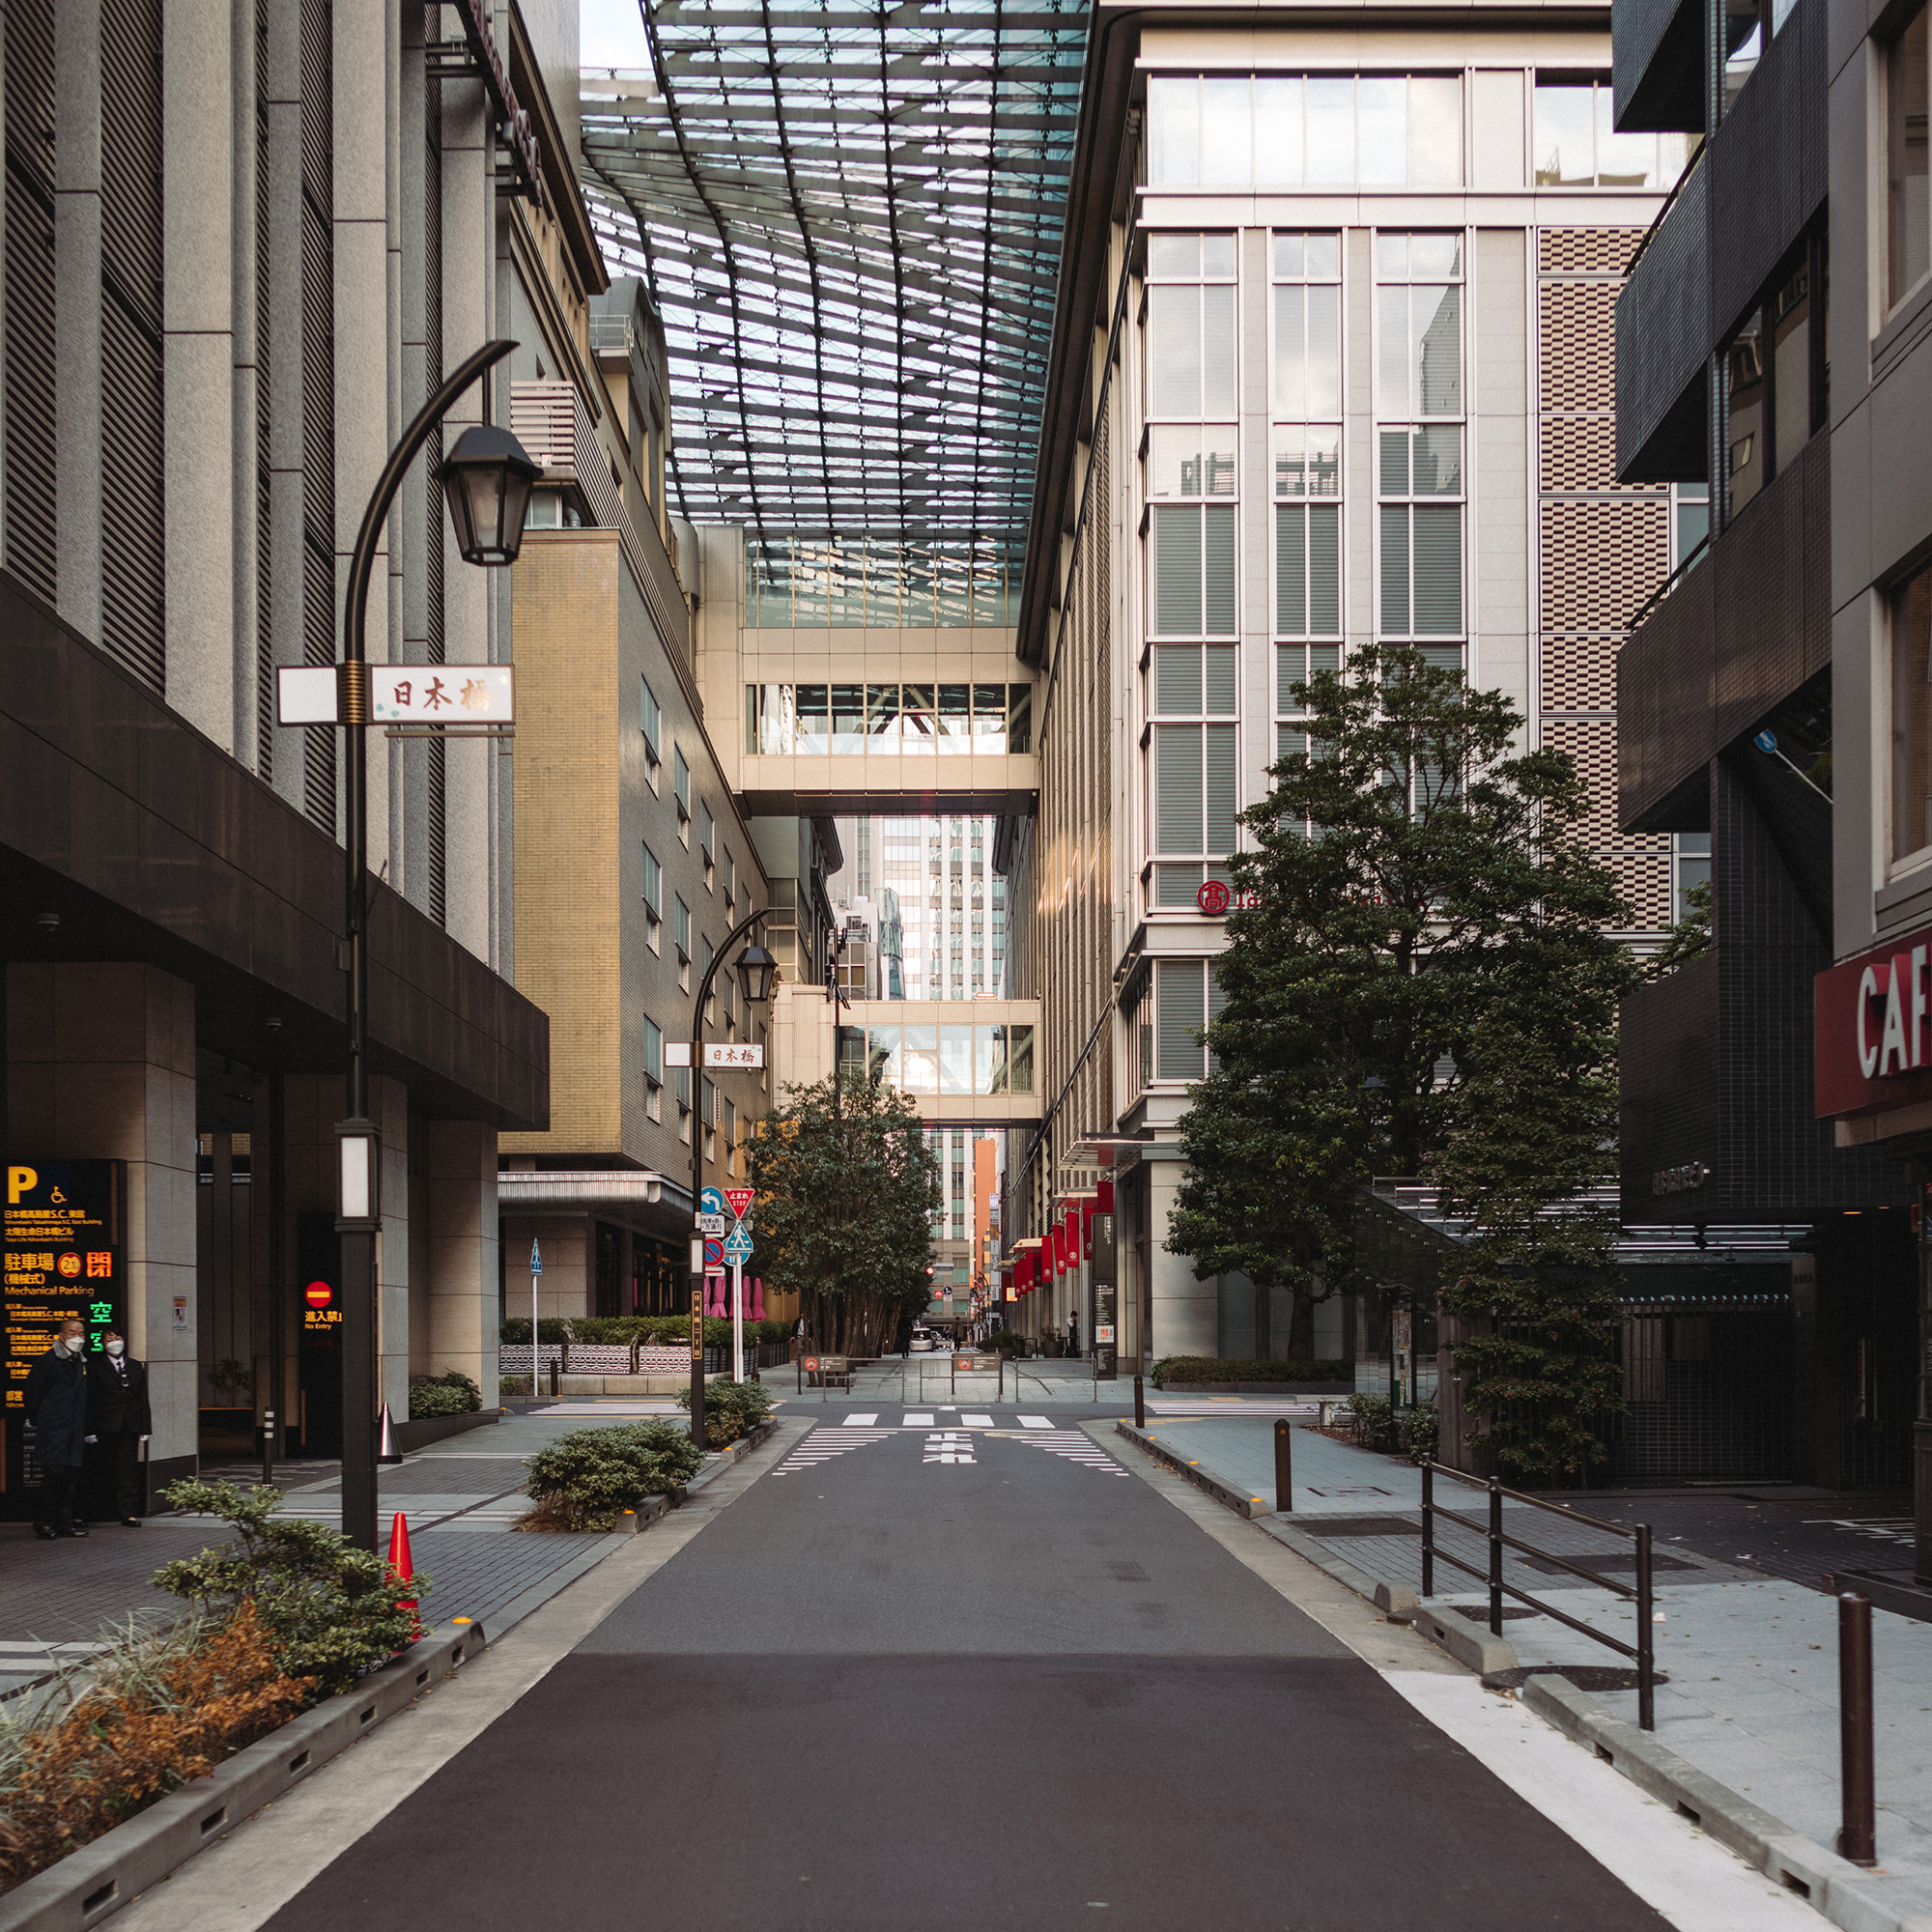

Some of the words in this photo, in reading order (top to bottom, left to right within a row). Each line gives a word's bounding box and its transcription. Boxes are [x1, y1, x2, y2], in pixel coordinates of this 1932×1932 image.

[393, 676, 493, 712] 日本橋
[713, 1048, 755, 1063] 日本橋
[8, 1166, 38, 1204] P
[4, 1253, 55, 1271] 駐車場
[87, 1252, 112, 1277] 閉
[5, 1286, 58, 1295] Mechanical
[59, 1286, 94, 1297] Parking
[90, 1301, 112, 1323] 空
